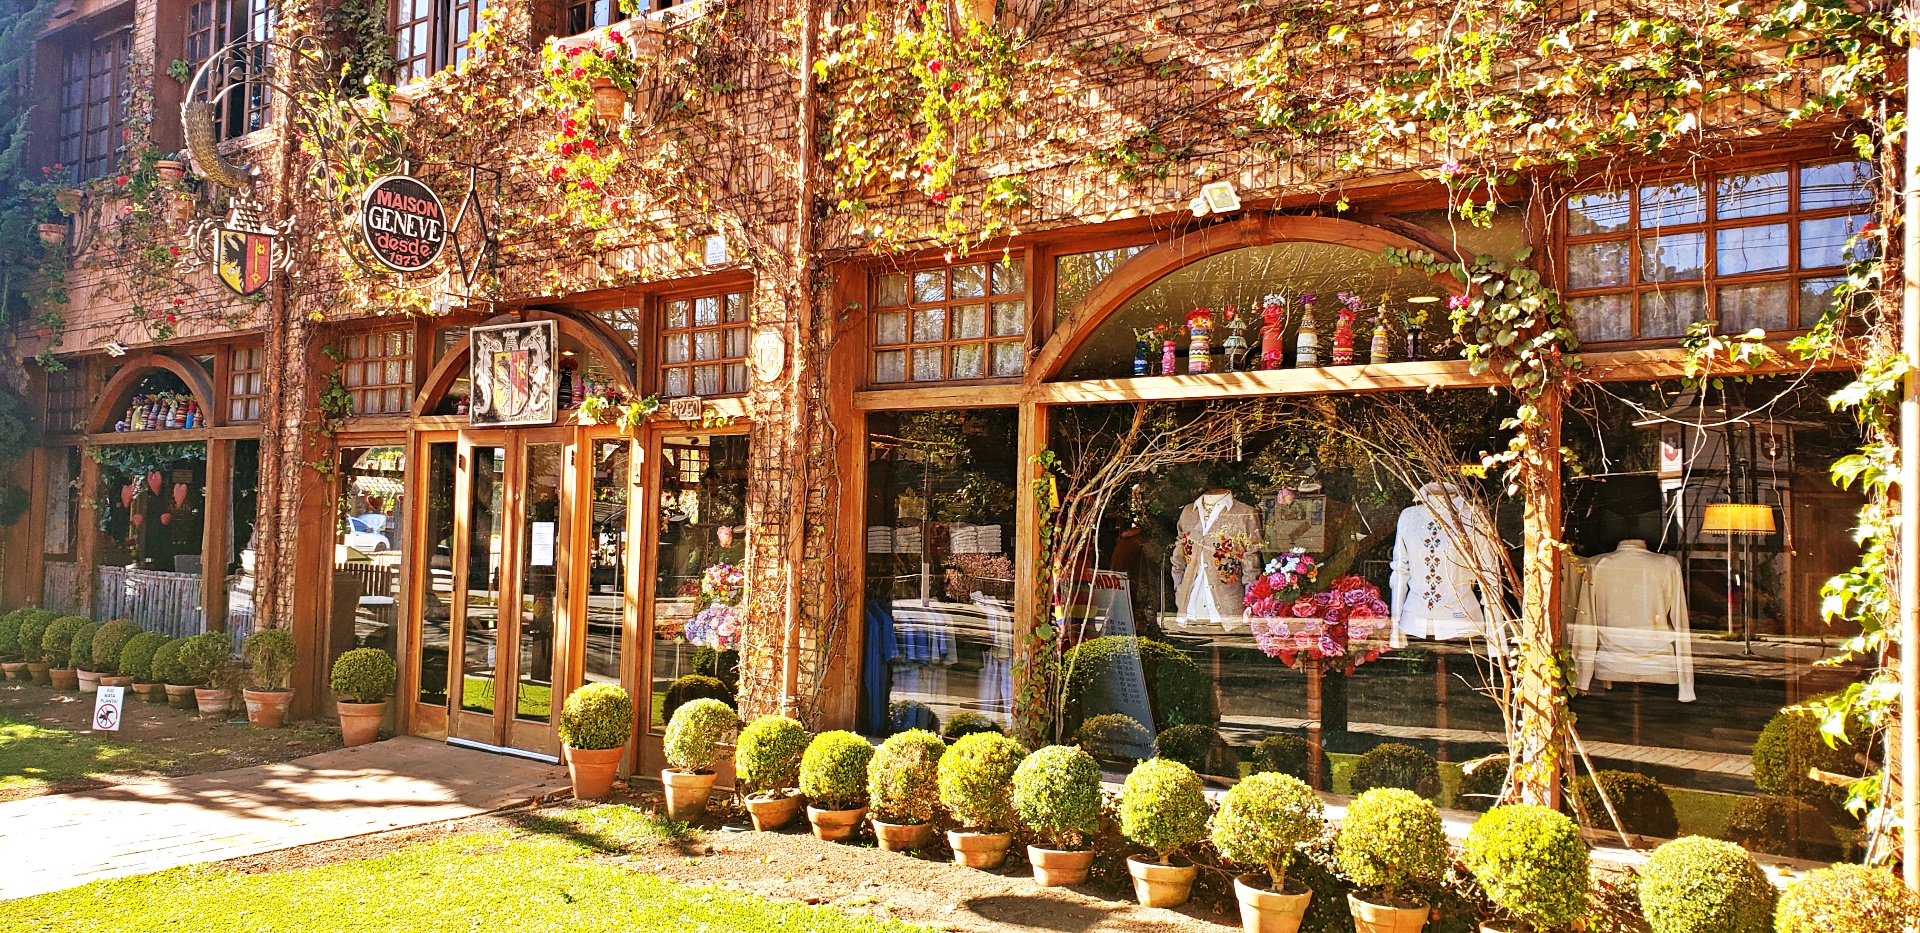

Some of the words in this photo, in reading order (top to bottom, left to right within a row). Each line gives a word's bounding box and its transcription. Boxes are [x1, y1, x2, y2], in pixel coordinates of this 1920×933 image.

[376, 189, 438, 218] MAISON
[368, 206, 441, 243] GENEVE
[376, 232, 430, 257] desde
[388, 252, 421, 266] 1973
